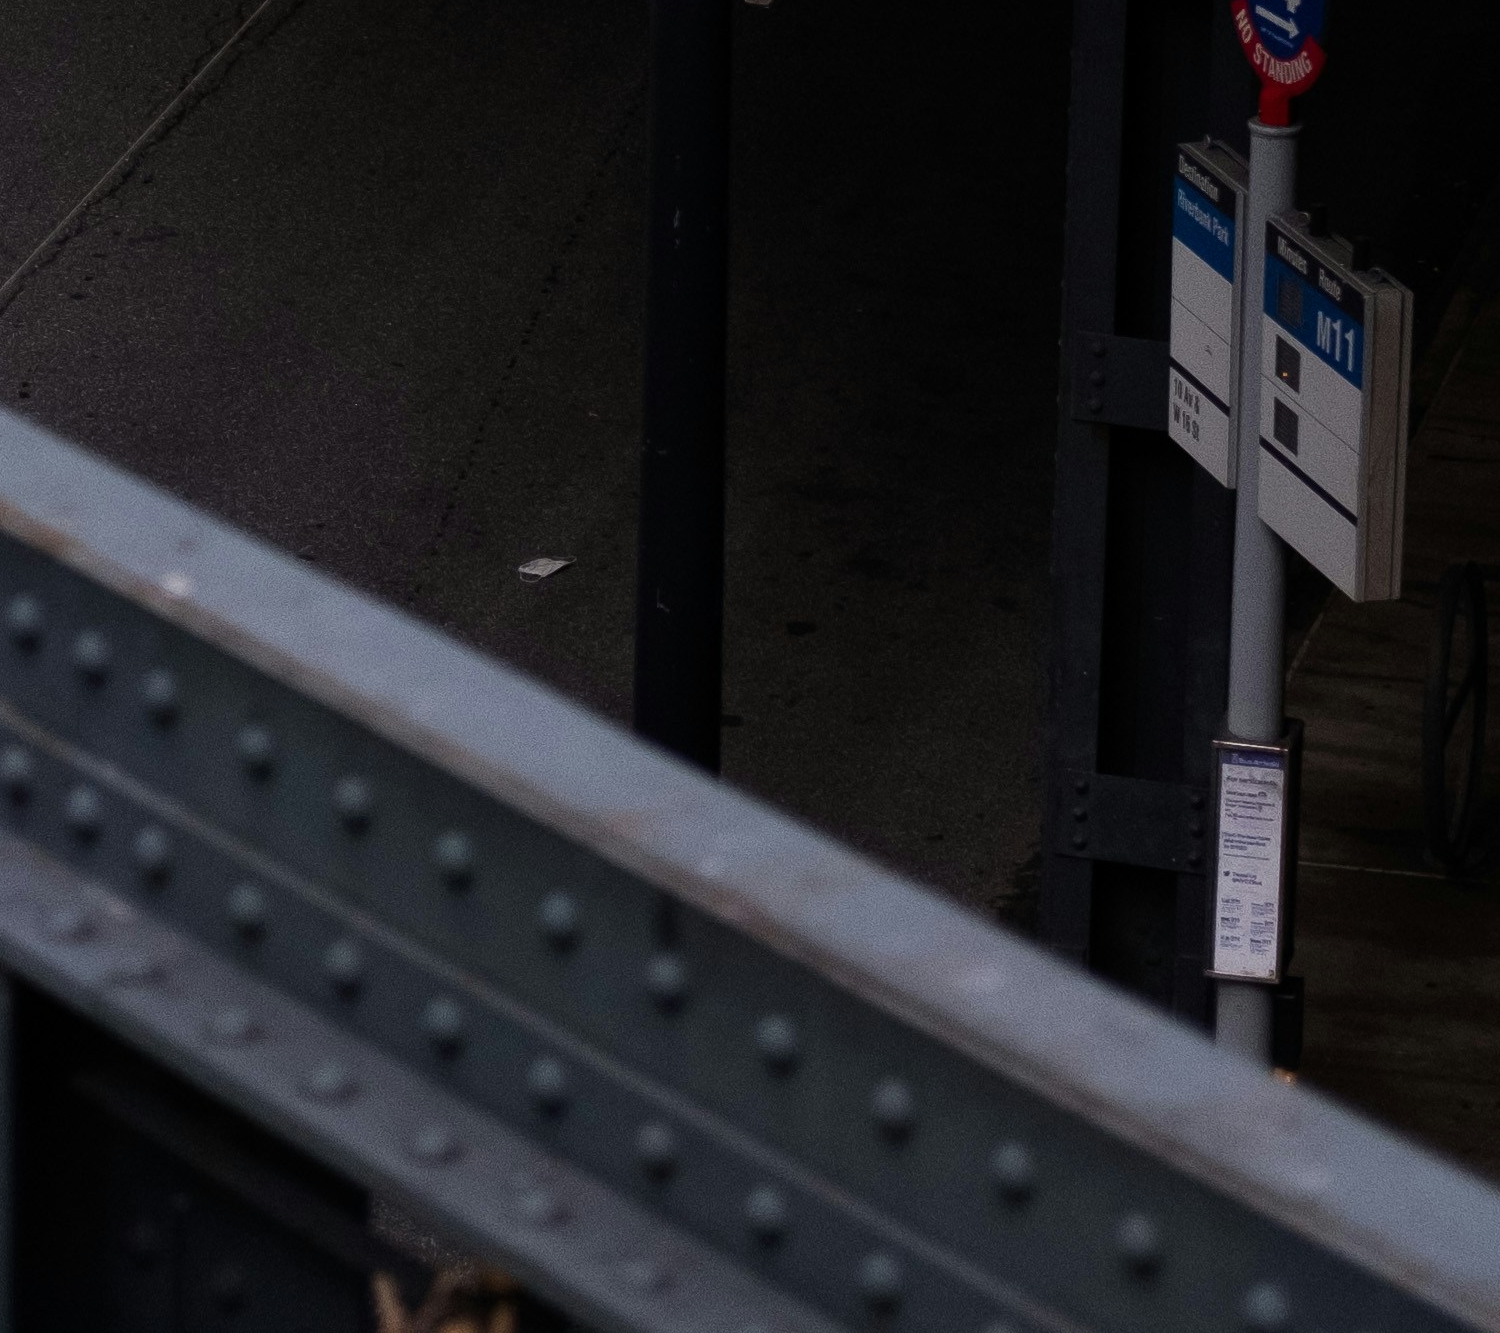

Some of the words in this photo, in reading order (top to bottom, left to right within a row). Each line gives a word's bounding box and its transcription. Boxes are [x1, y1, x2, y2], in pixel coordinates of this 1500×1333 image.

[1235, 8, 1253, 44] NO
[1253, 42, 1313, 85] STANDING
[1316, 309, 1356, 373] M11
